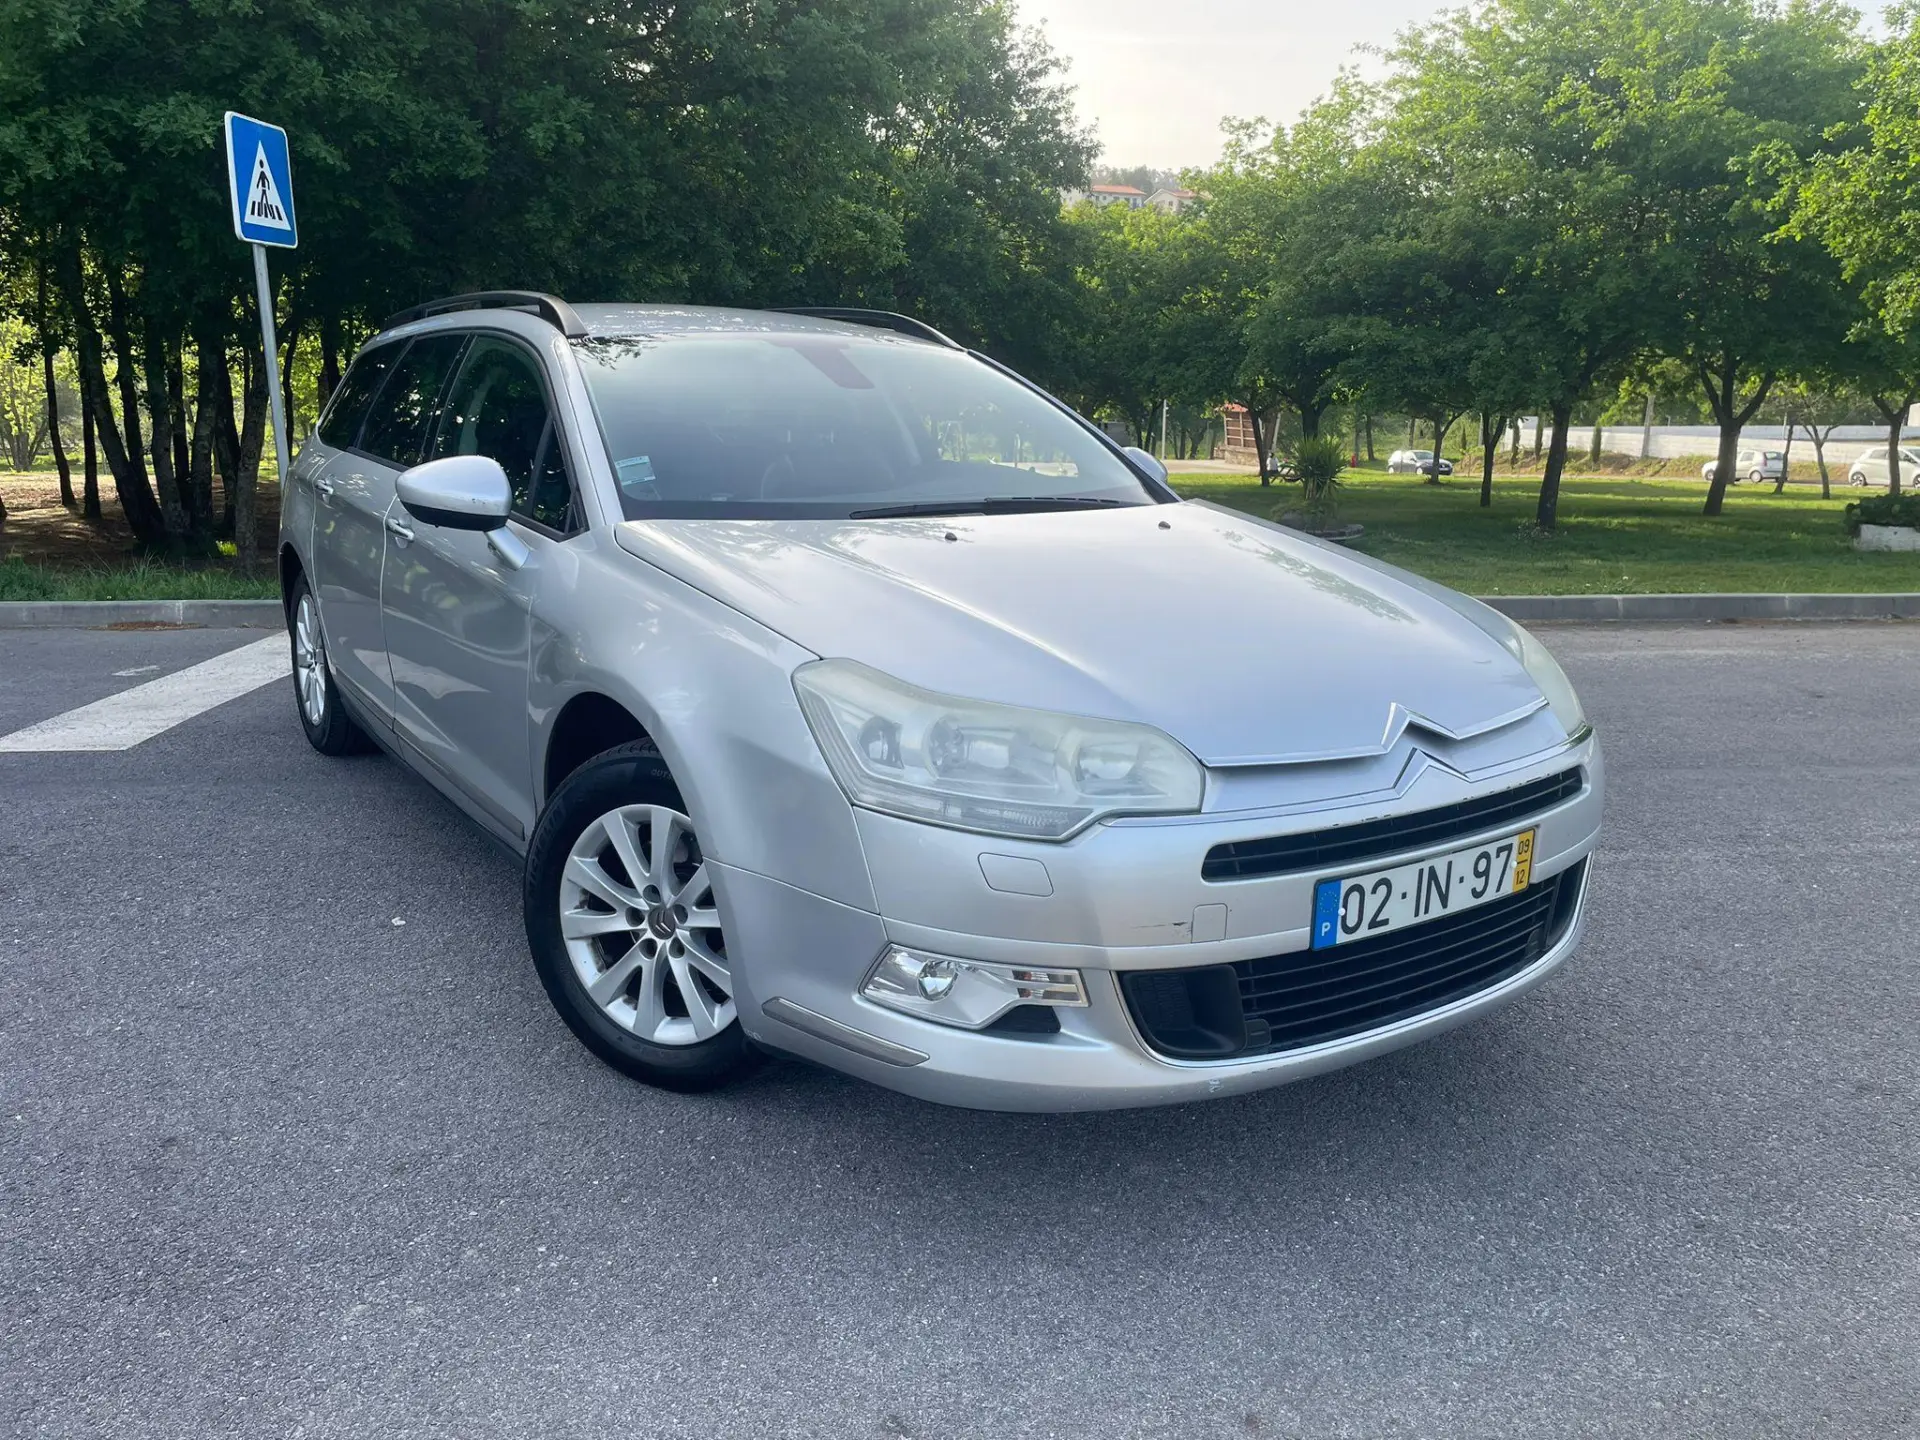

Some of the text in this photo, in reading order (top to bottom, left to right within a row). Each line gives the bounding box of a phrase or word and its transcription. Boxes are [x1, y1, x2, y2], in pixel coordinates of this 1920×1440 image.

[1518, 838, 1530, 855] 09
[1515, 869, 1525, 884] 12
[1321, 922, 1330, 936] P
